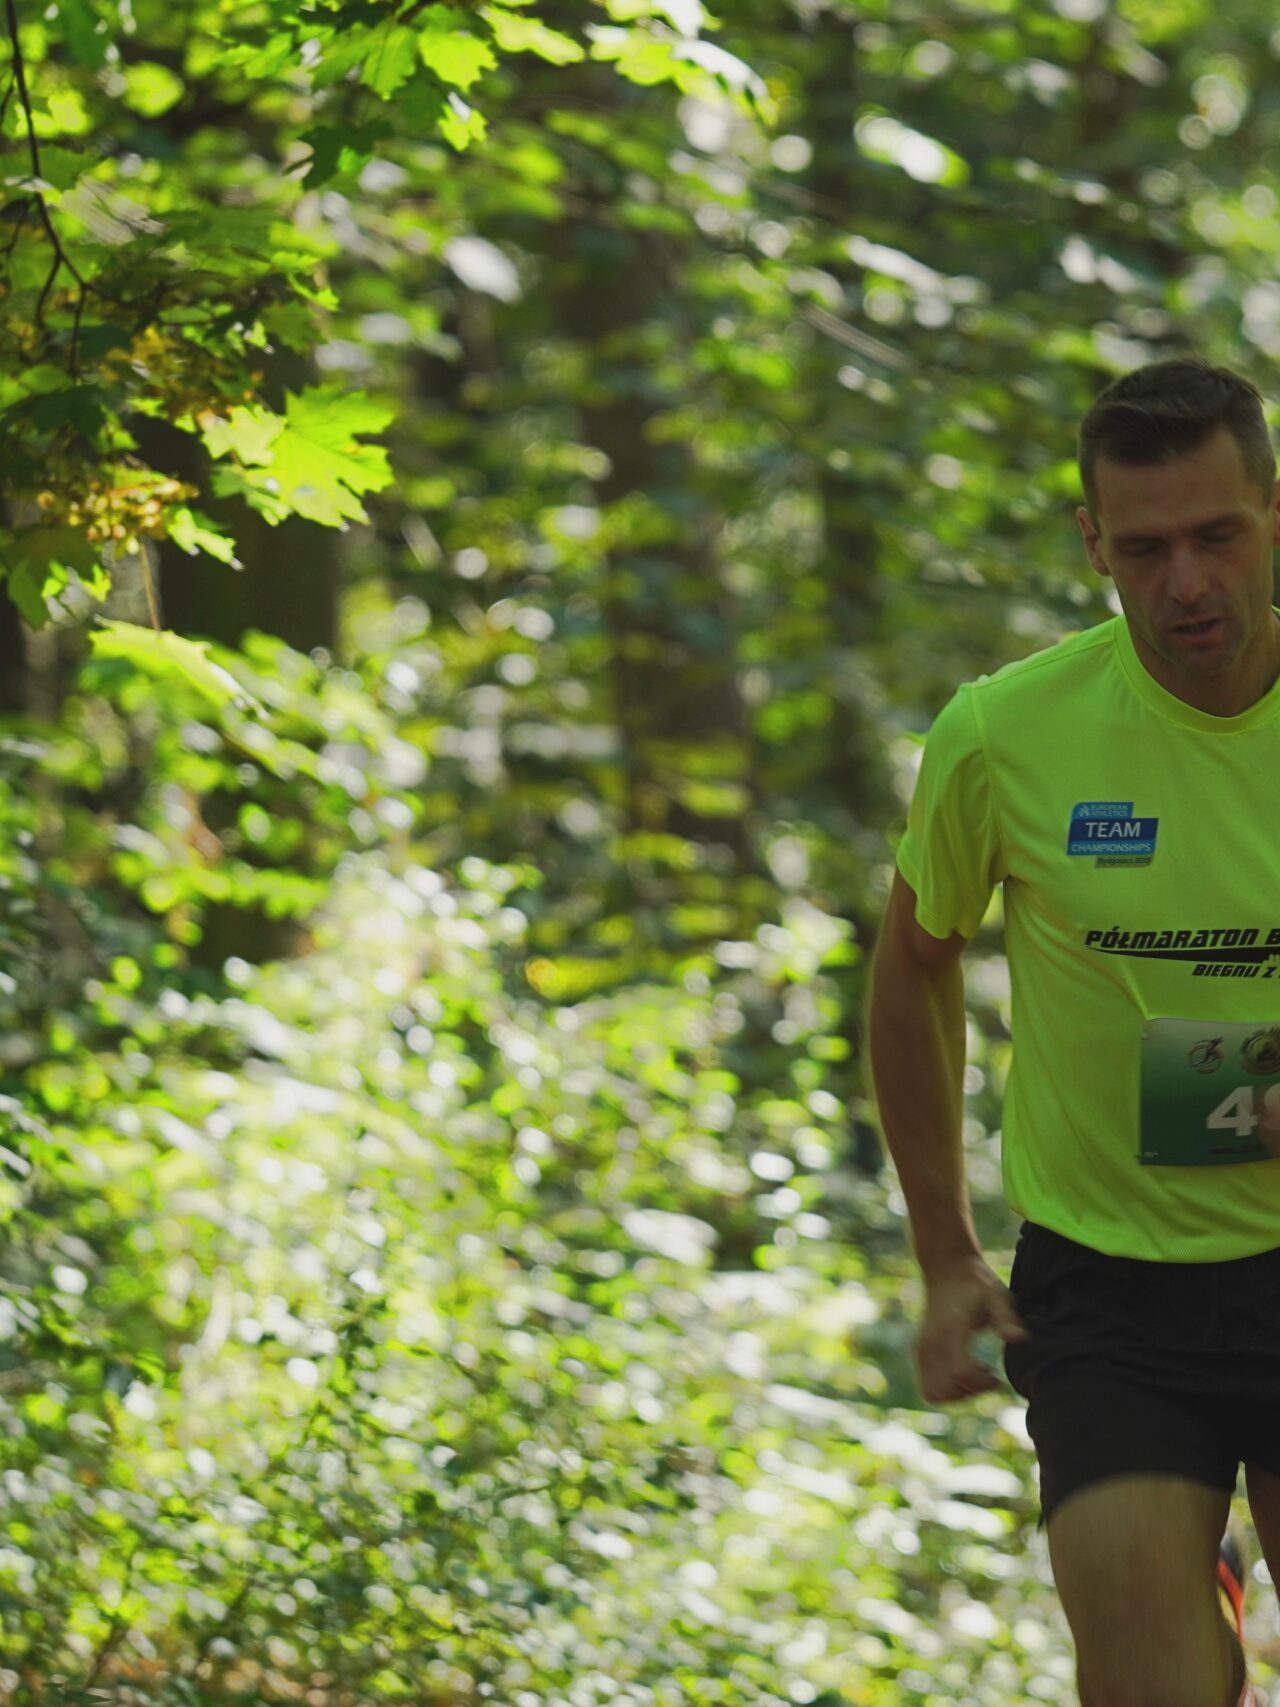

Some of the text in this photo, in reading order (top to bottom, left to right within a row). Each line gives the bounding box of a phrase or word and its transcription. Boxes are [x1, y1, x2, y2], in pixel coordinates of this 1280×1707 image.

[1085, 822, 1141, 838] TEAM
[1071, 843, 1151, 852] CHAMPIONSHIPS
[1085, 926, 1259, 949] PÓŁMARATON
[1262, 966, 1277, 978] Z
